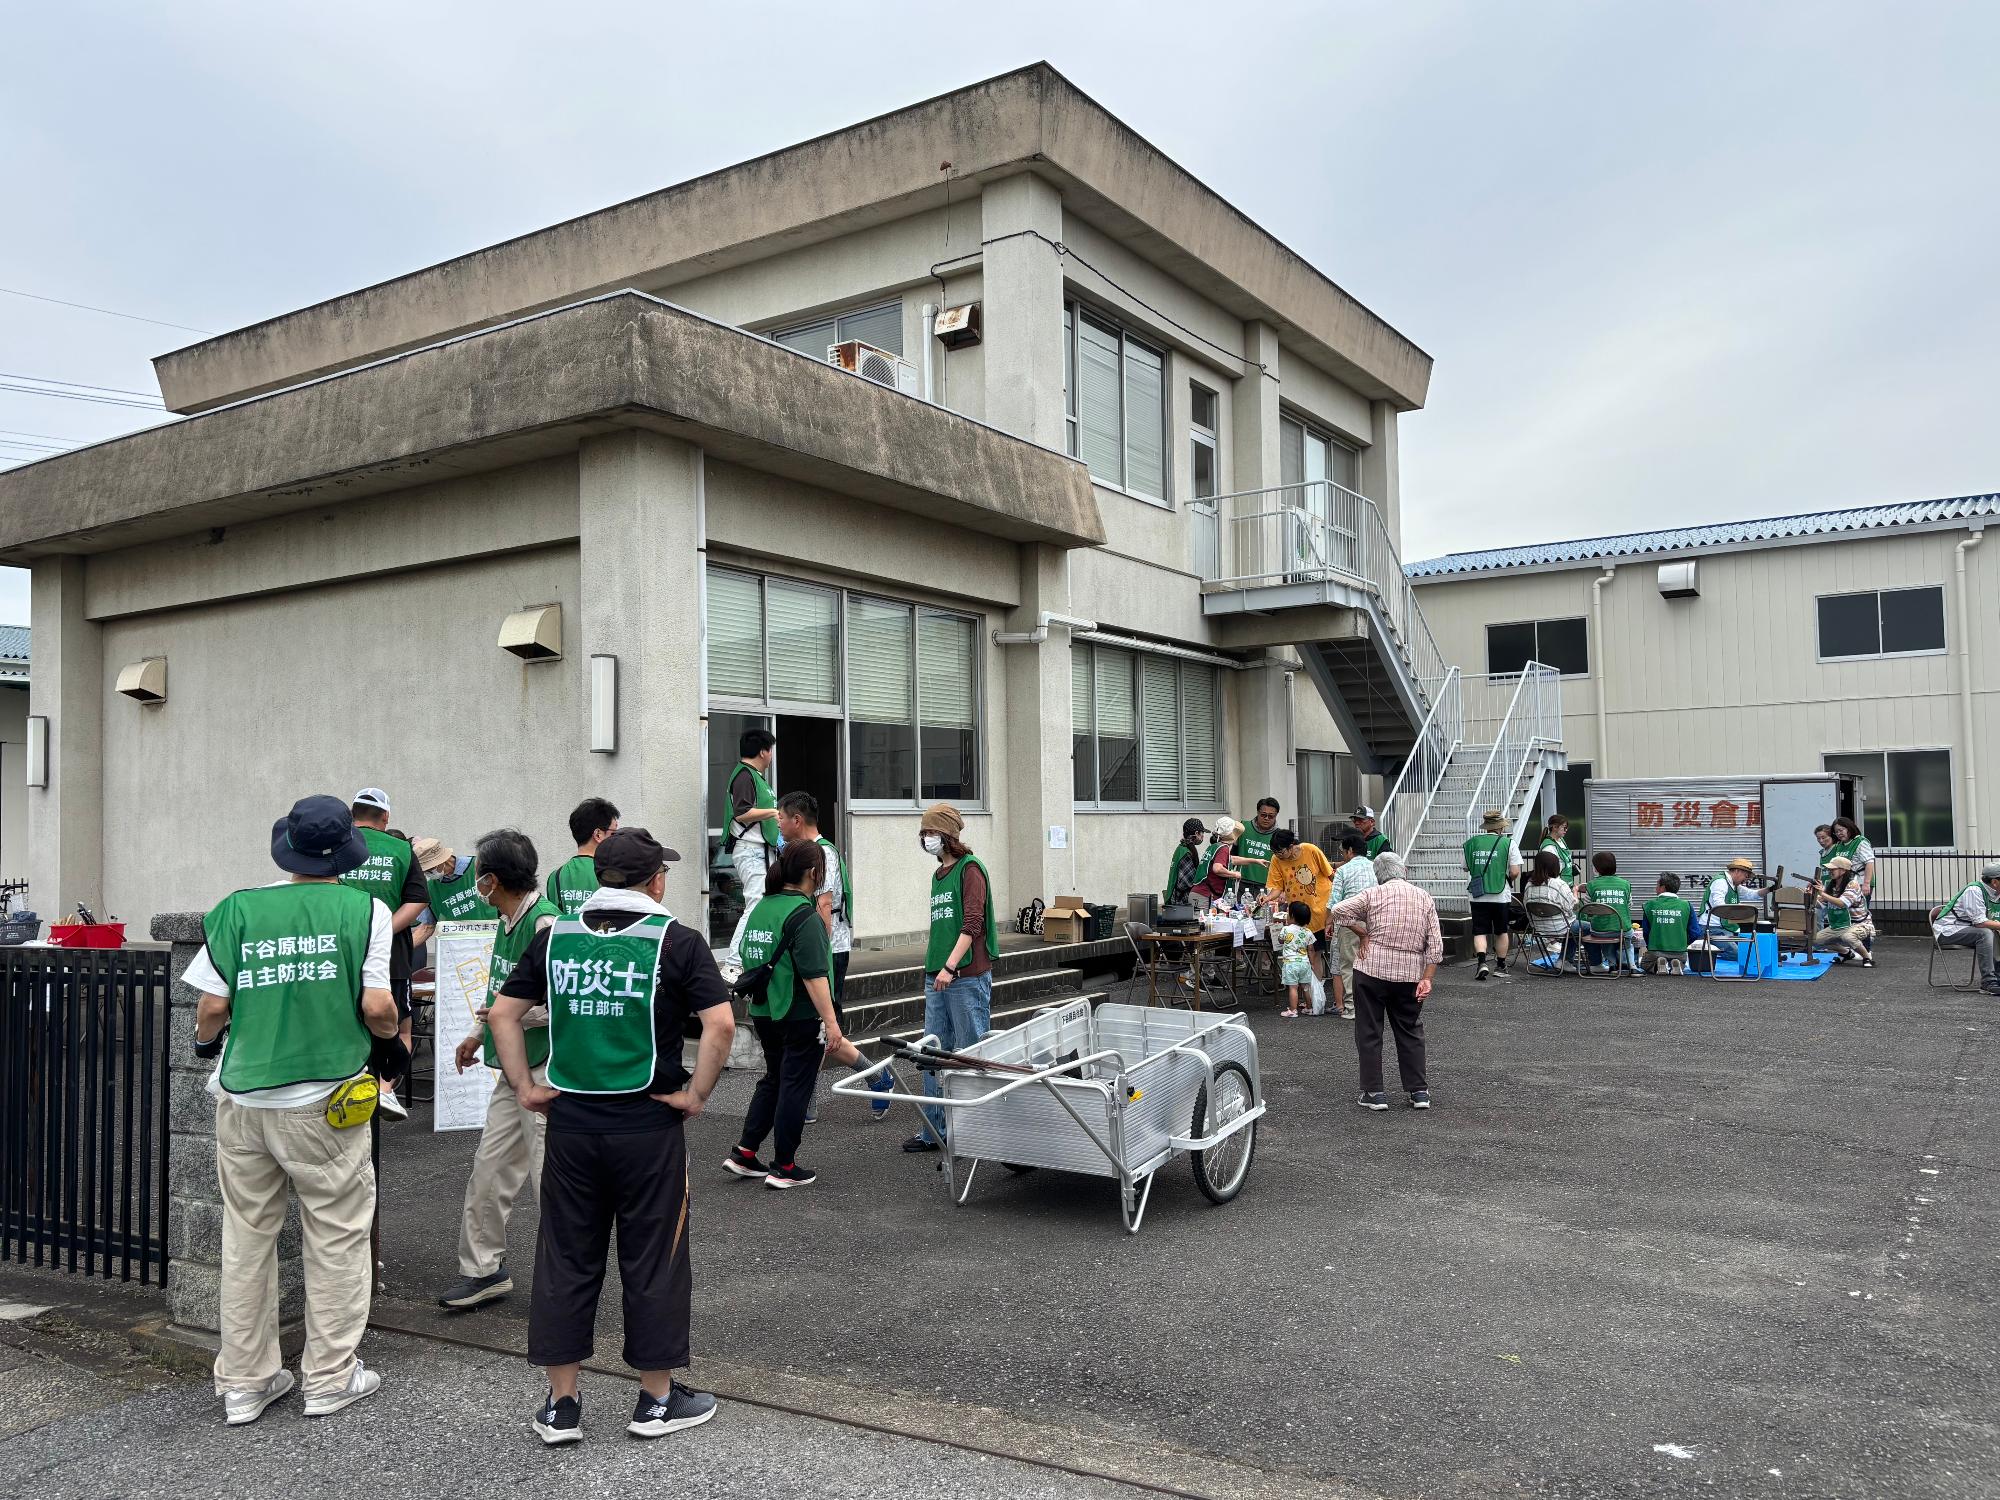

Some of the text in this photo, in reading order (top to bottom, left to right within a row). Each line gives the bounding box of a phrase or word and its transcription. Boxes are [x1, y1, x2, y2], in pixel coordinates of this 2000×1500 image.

[451, 899, 476, 917] 自治会
[241, 934, 338, 963] 下谷原地区
[237, 959, 338, 990] 自主防災会
[551, 958, 648, 998] 防災士
[568, 998, 625, 1017] 春日部市
